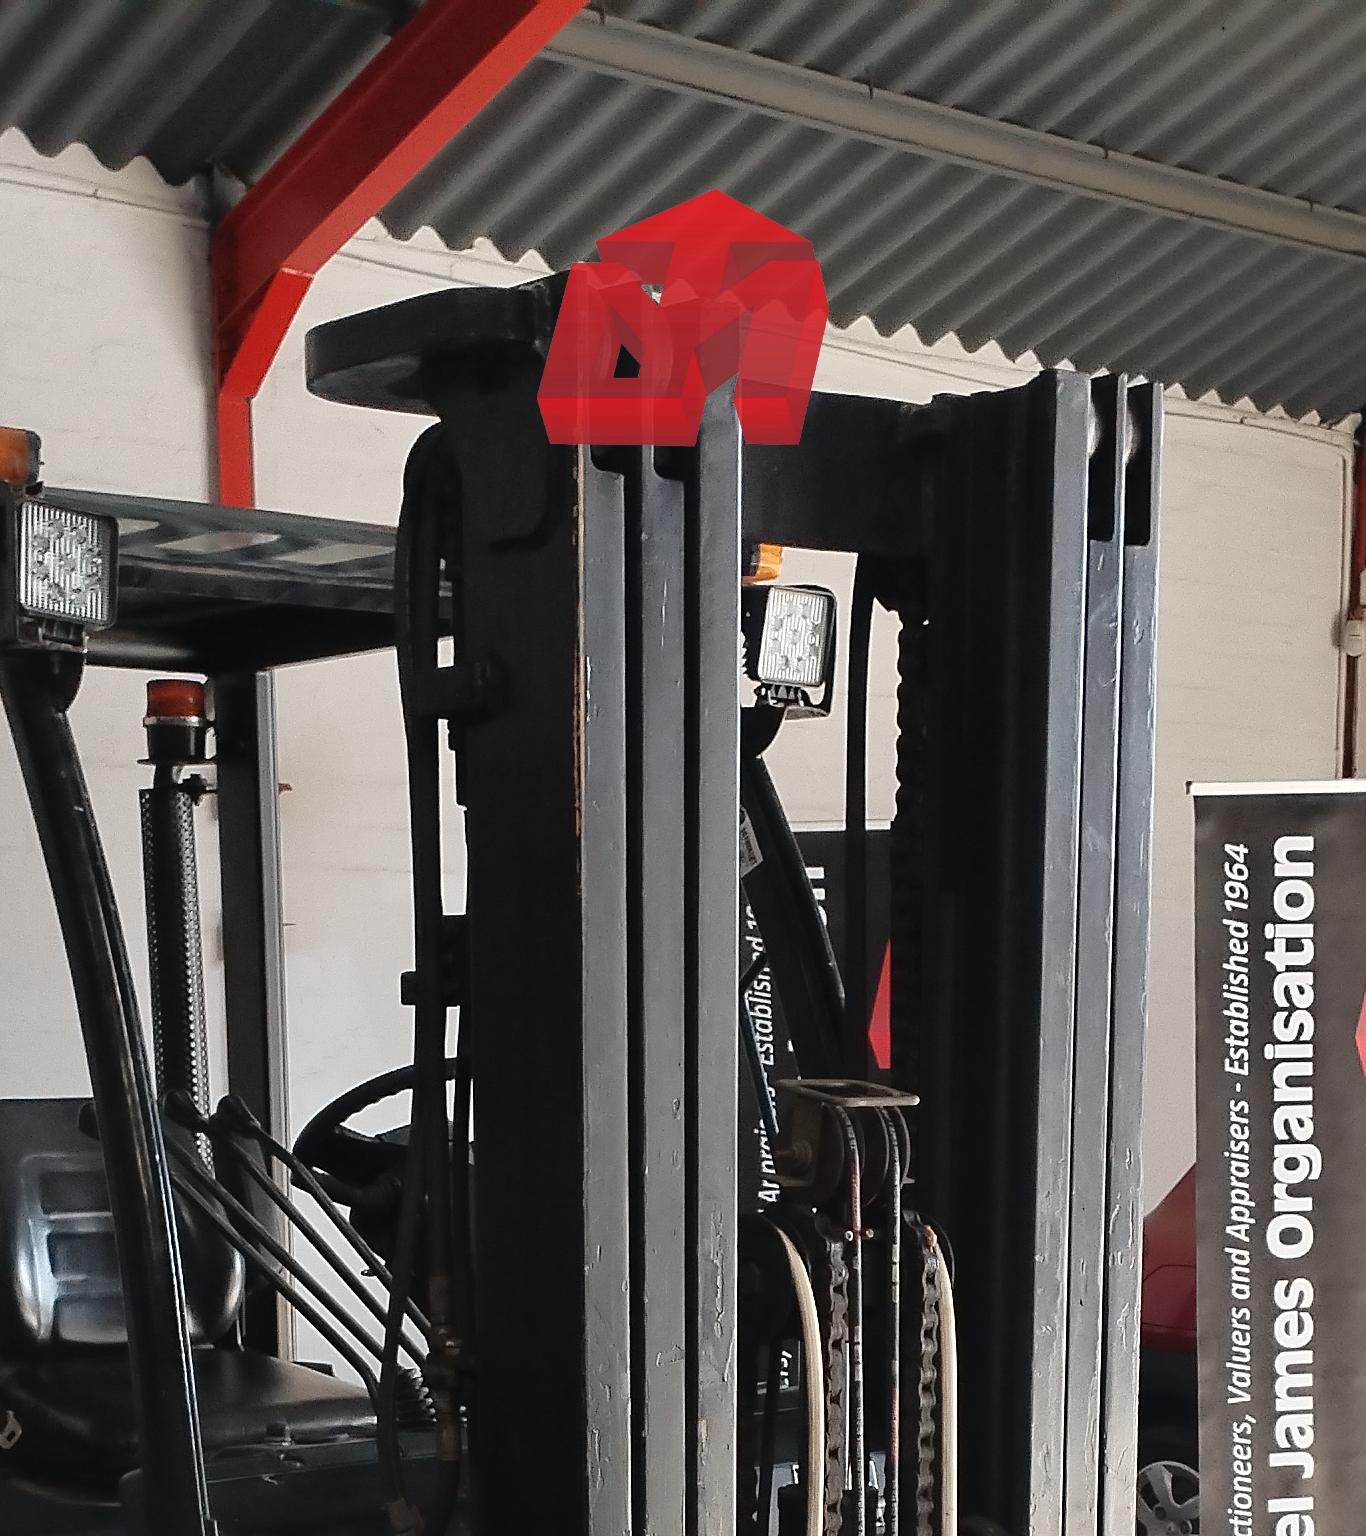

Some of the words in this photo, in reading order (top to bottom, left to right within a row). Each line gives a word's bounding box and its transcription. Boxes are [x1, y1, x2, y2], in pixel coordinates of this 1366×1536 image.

[1224, 843, 1249, 911] 1964
[1222, 920, 1249, 1076] Established
[1264, 835, 1322, 1259] Organisation
[1223, 1099, 1256, 1243] Appraisers
[1224, 1248, 1251, 1300] and
[1225, 1307, 1251, 1405] Valuers
[1267, 1277, 1314, 1480] James
